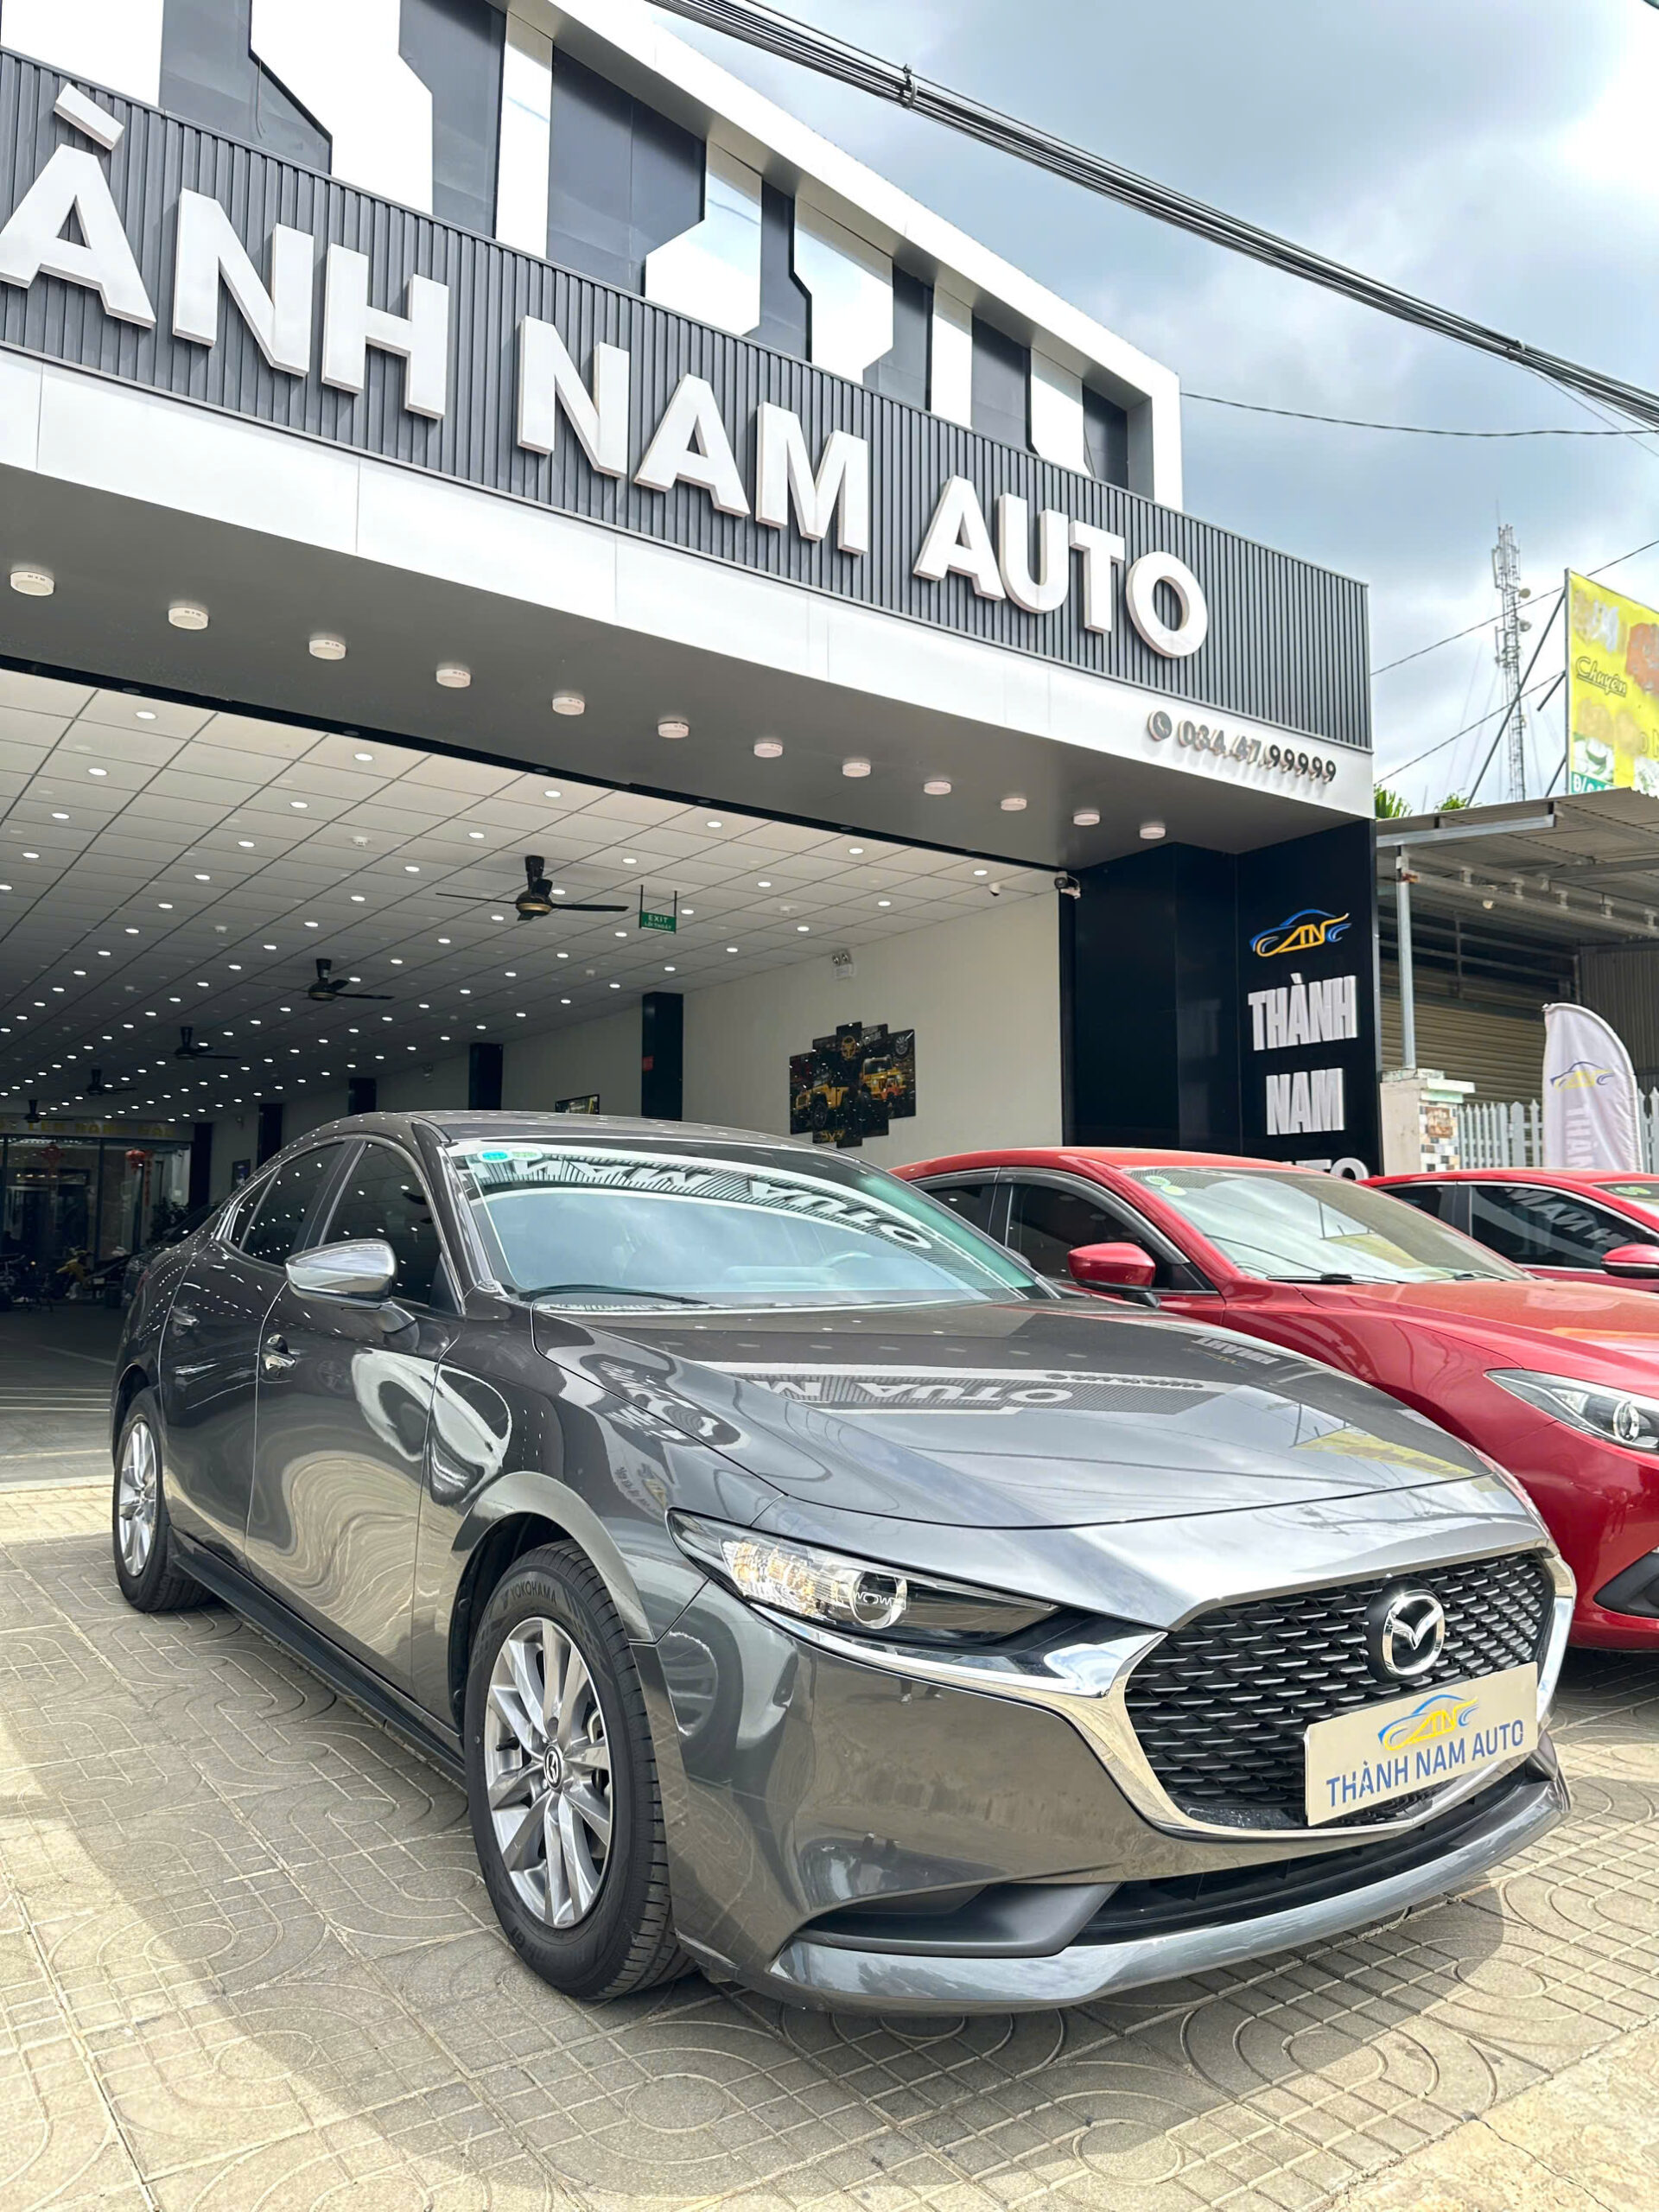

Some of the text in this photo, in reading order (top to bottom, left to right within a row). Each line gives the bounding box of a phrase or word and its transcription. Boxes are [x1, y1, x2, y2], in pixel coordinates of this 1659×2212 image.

[516, 315, 869, 556] NAM
[912, 474, 1209, 658] AUTO
[647, 914, 669, 924] EXIT
[1247, 972, 1358, 1051] THÀNH
[1265, 1067, 1345, 1135] NAM
[510, 1580, 557, 1606] YOKOHAMA
[1325, 1719, 1524, 1808] THÀNH NAM AUTO
